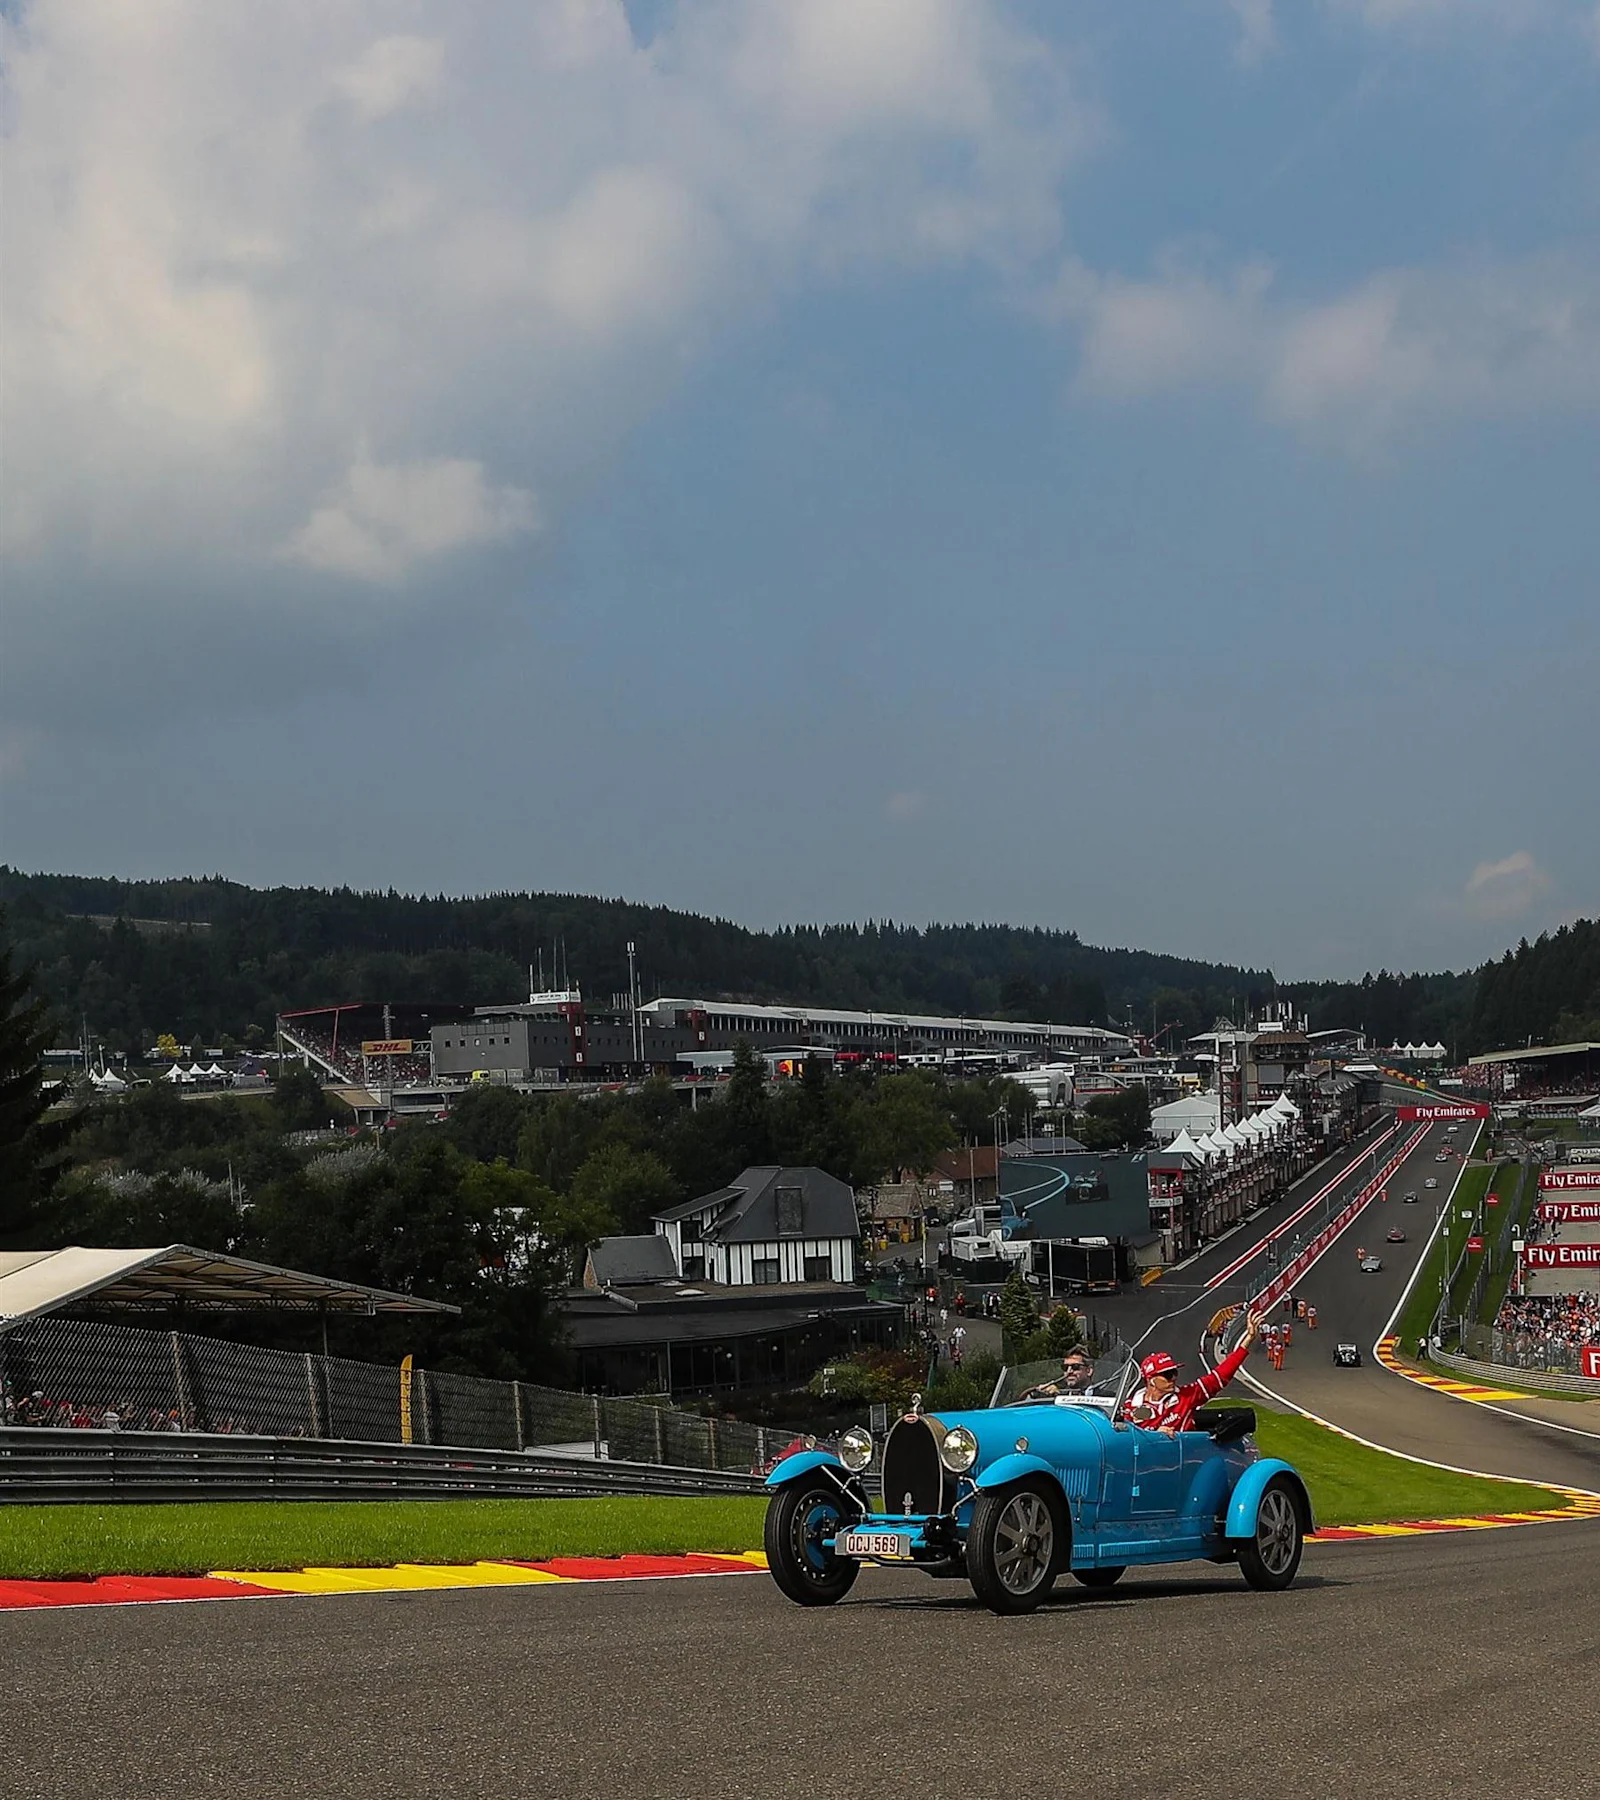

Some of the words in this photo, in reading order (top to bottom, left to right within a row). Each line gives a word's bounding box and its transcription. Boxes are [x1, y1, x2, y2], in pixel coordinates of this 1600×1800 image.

[1416, 1107, 1433, 1118] Fly
[1434, 1106, 1476, 1117] Emirates
[1544, 1174, 1565, 1187] Fly
[1545, 1205, 1568, 1219] Fly
[1528, 1247, 1555, 1265] Fly
[848, 1536, 870, 1552] OCJ
[874, 1536, 896, 1552] 569
